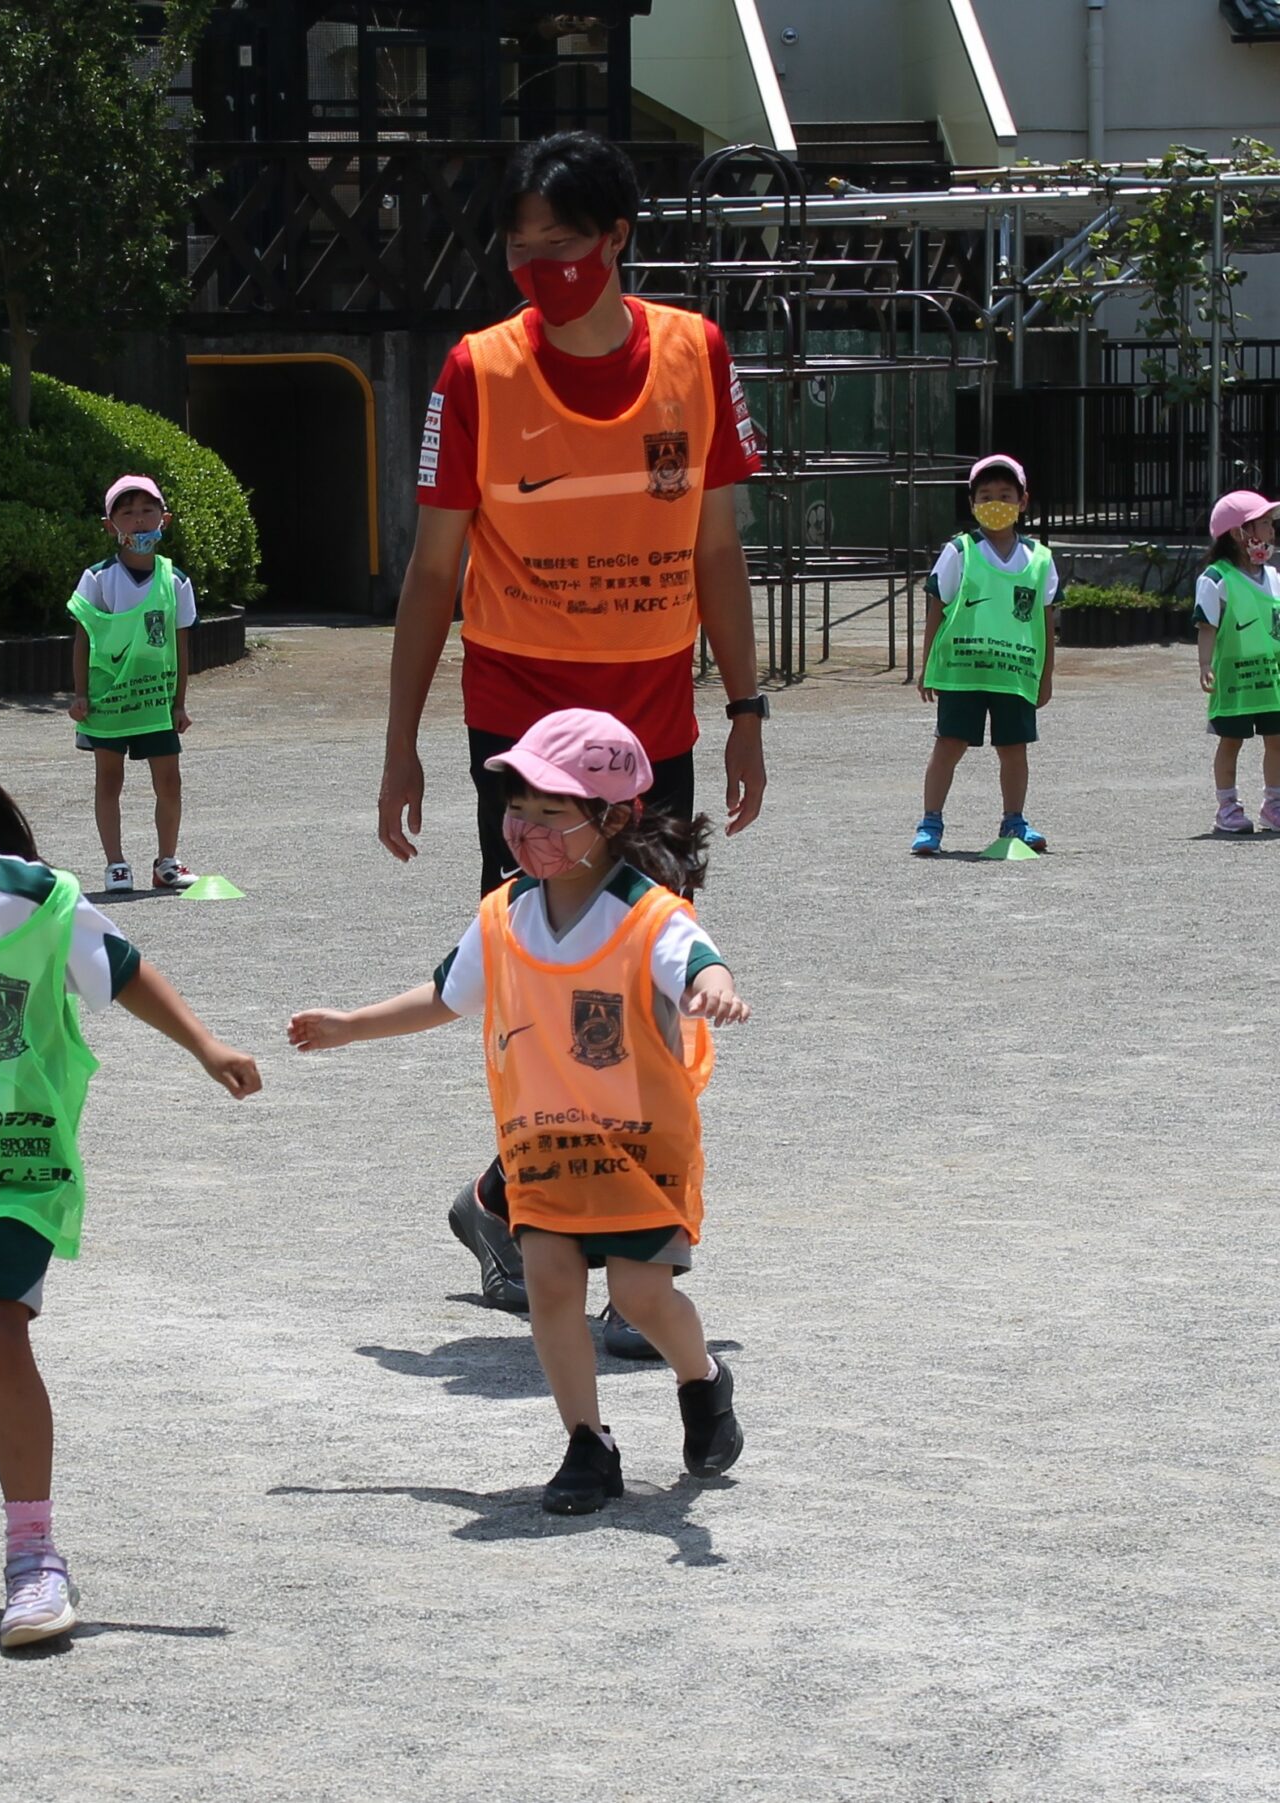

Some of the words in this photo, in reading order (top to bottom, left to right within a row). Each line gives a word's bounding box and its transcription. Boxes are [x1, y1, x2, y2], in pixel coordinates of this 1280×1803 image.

[587, 554, 640, 569] EneCle
[633, 597, 668, 613] KFC
[587, 746, 636, 776] ことの
[0, 1137, 51, 1151] SPORTS
[593, 1157, 630, 1176] KFC
